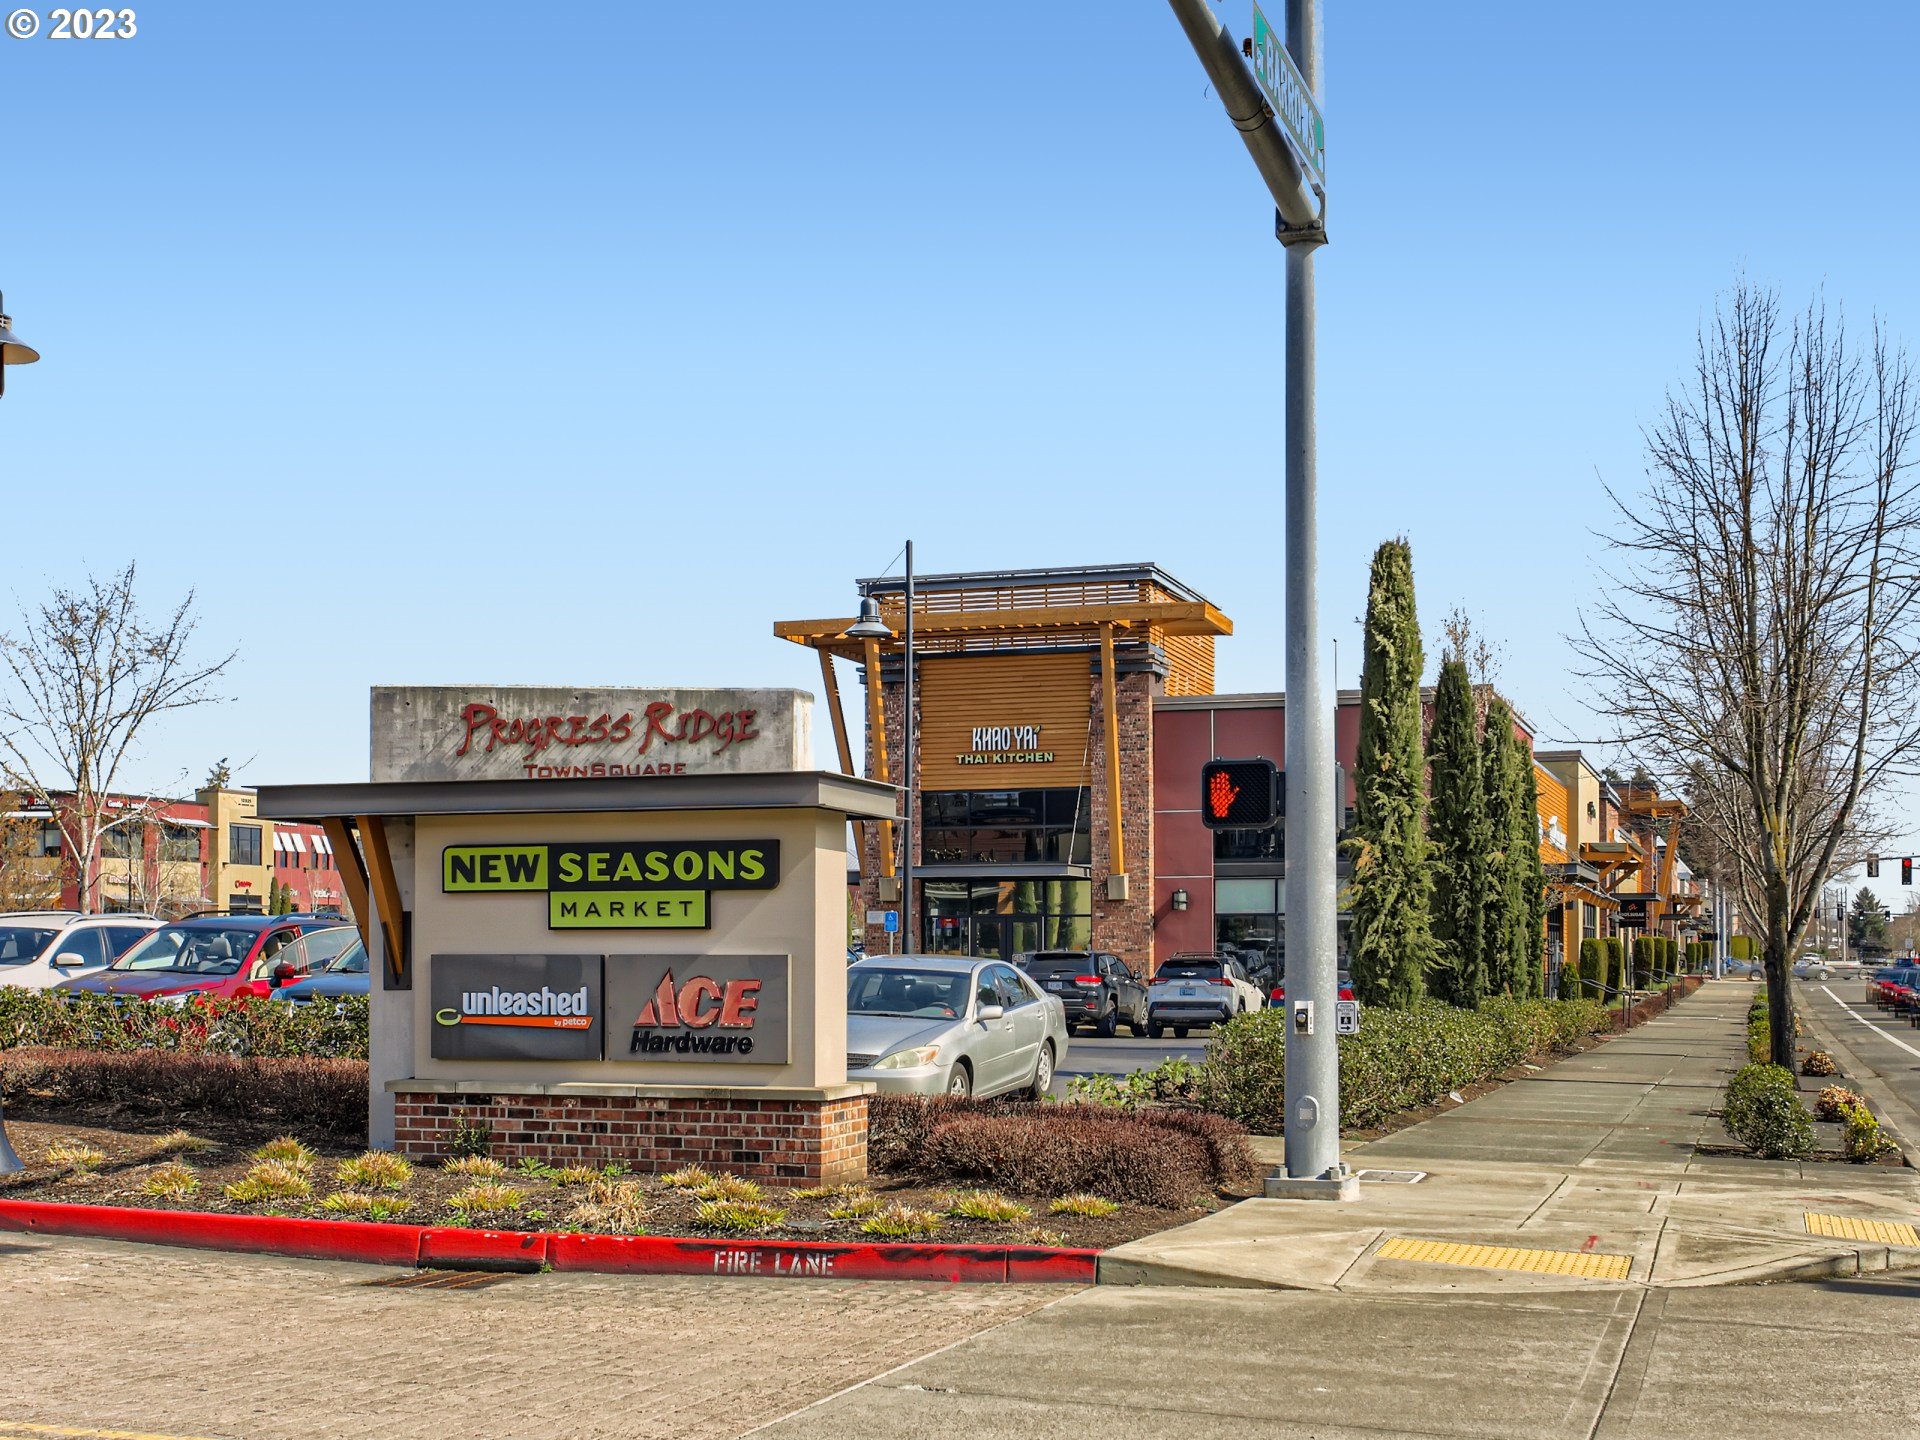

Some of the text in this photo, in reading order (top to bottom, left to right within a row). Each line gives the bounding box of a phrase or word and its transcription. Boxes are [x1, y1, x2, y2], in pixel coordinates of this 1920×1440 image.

[1266, 33, 1315, 158] BARROWS
[455, 701, 760, 761] PROGRESS RIDGE
[972, 726, 1011, 751] KHAO
[956, 752, 1054, 764] THAI KITCHEN
[451, 849, 766, 883] NEW SEASONS
[561, 901, 693, 917] MARKET
[462, 986, 588, 1016] unleashed
[633, 967, 762, 1029] ACE
[554, 1018, 587, 1027] by petco
[630, 1030, 755, 1054] Hardware
[713, 1251, 835, 1276] FIRE LANE
